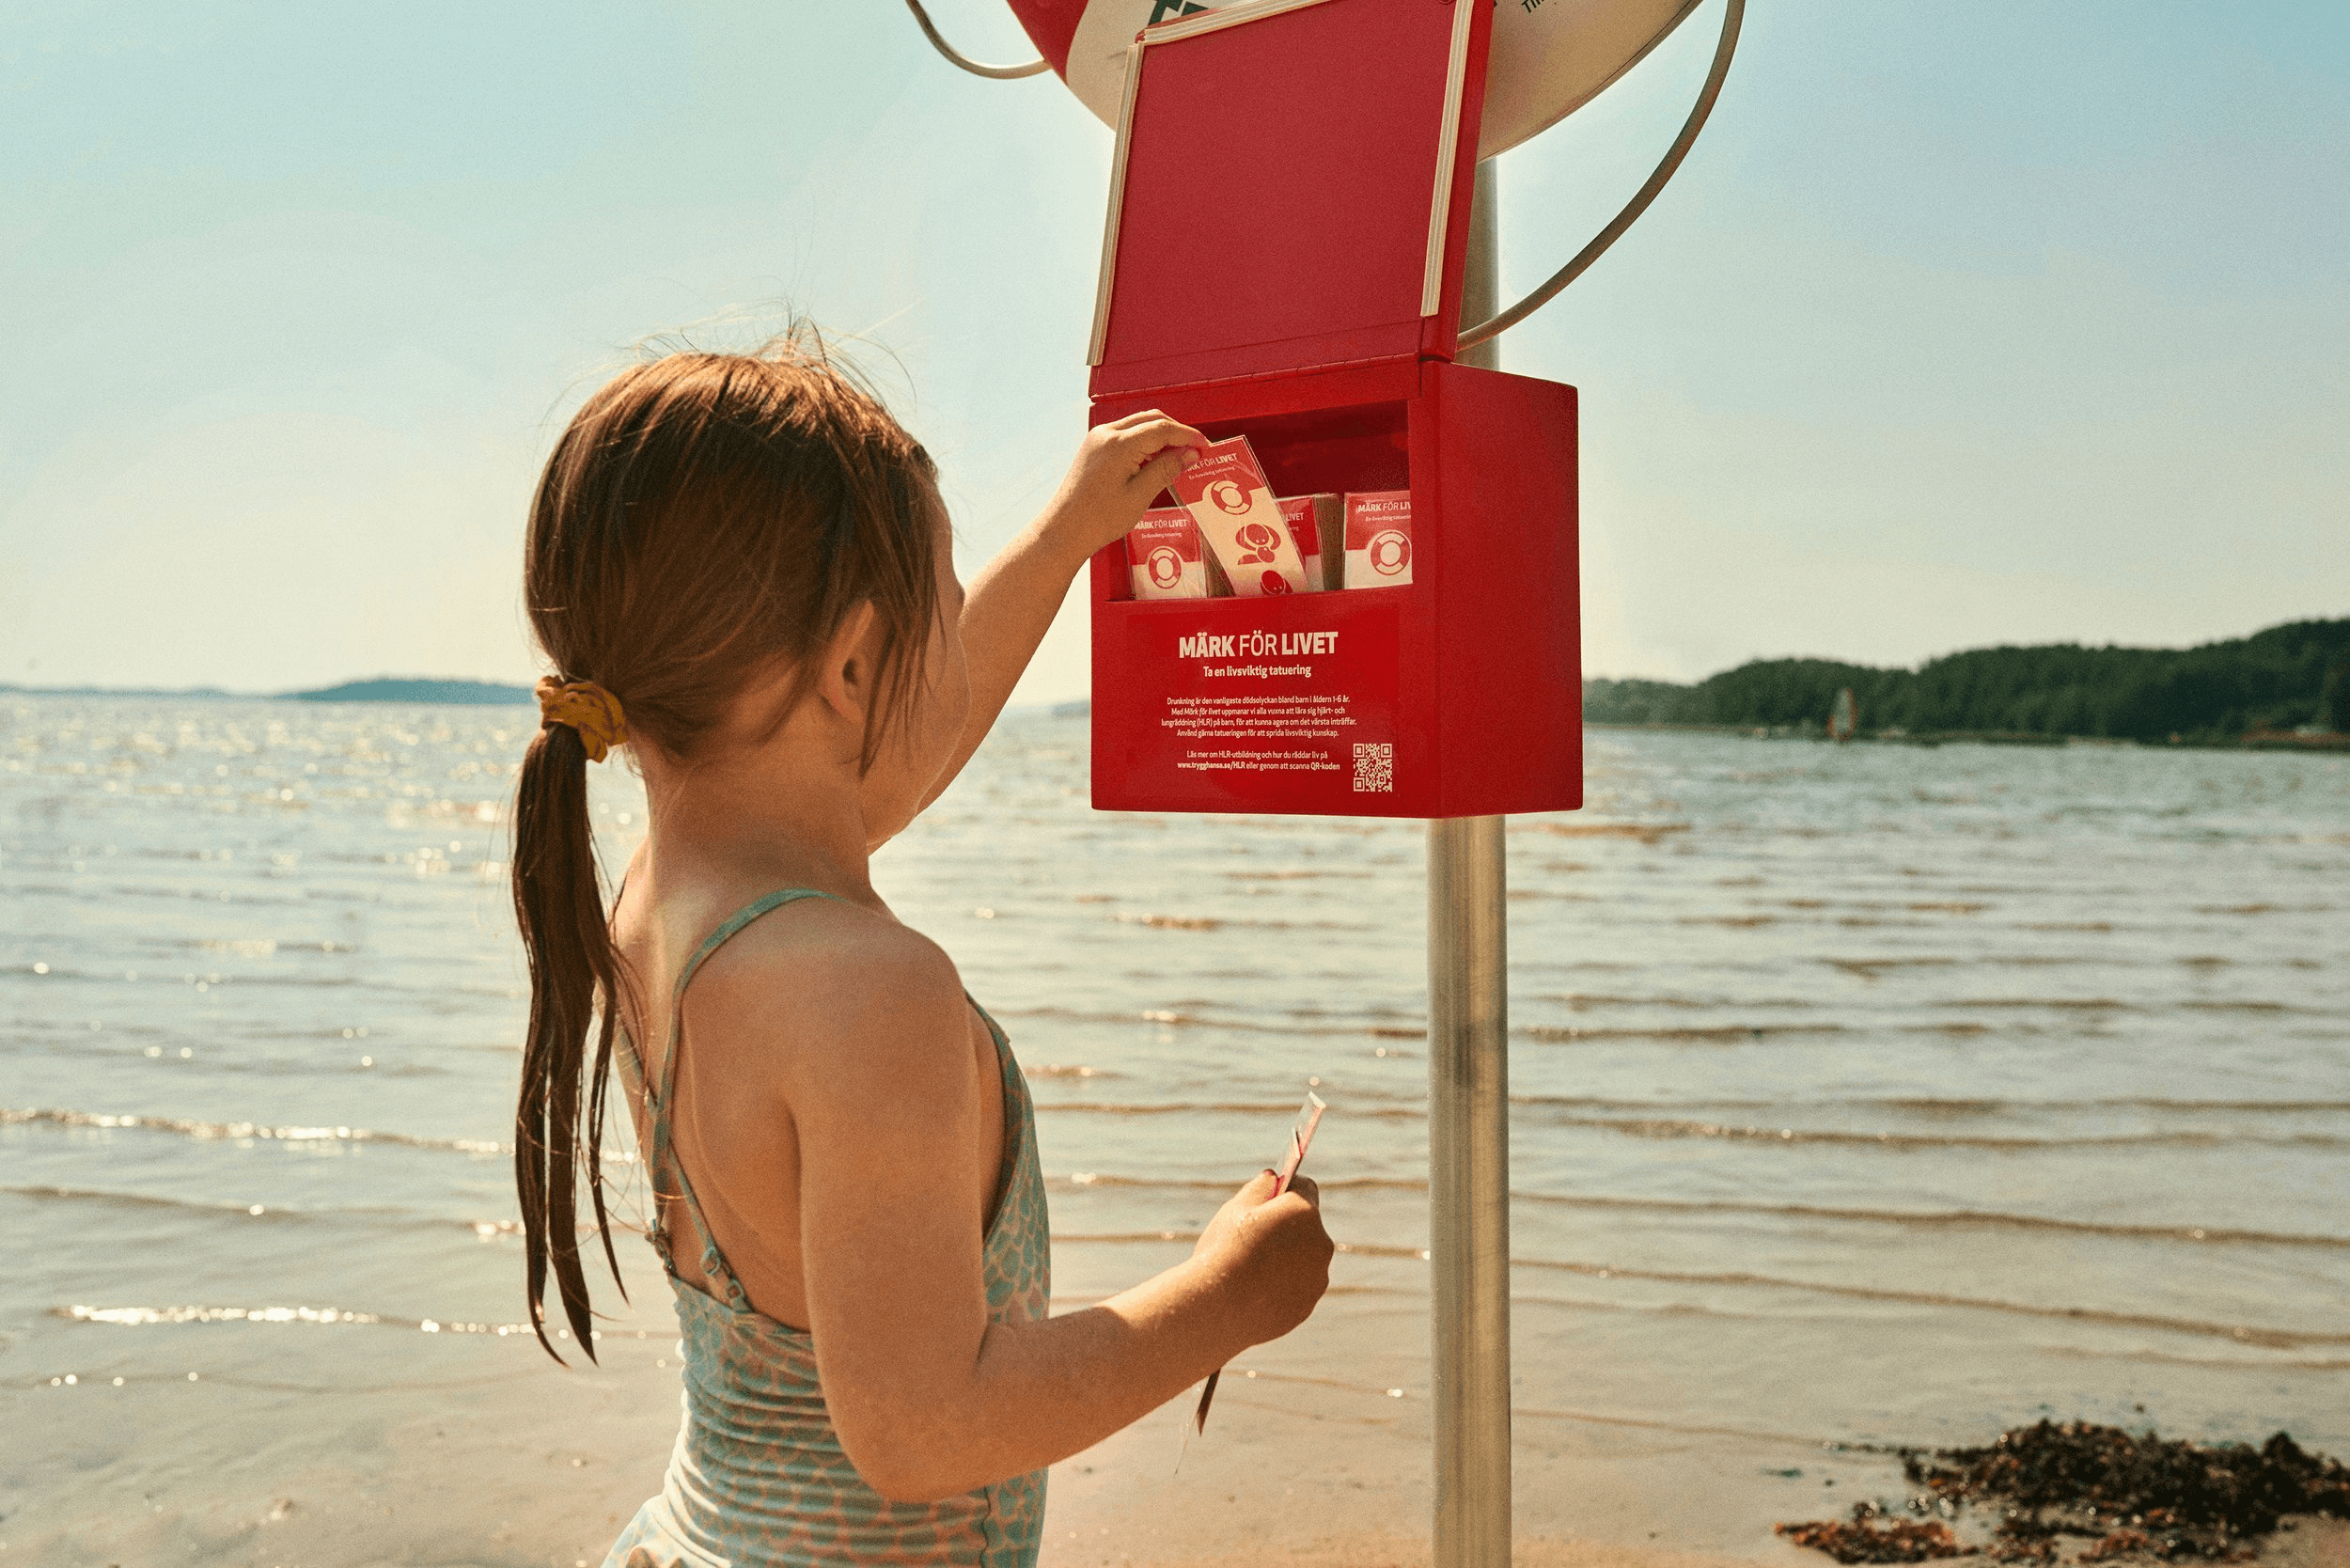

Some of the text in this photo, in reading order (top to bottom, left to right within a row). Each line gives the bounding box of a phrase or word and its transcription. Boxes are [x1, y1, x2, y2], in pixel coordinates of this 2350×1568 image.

[1199, 458, 1216, 468] FÖR
[1215, 452, 1238, 464] LIVET
[1357, 502, 1382, 512] MÄRK
[1383, 500, 1400, 511] FÖR
[1154, 519, 1168, 528] FÖR
[1168, 519, 1187, 527] LIVET
[1179, 629, 1339, 658] MÄRK FÖR LIVET
[1203, 664, 1311, 679] Ta en livsviktig tatuering
[1167, 698, 1195, 707] Drunkning
[1214, 697, 1241, 707] vanligaste
[1242, 696, 1277, 706] dödsolyckan
[1278, 696, 1294, 704] bland
[1295, 696, 1308, 704] barn
[1309, 696, 1312, 704] i
[1313, 695, 1331, 704] åldern
[1342, 695, 1351, 703] år.
[1198, 707, 1208, 717] för
[1208, 707, 1221, 715] livet
[1221, 708, 1249, 717] uppmanar
[1250, 707, 1256, 715] vi
[1256, 707, 1267, 715] alla
[1294, 706, 1307, 714] lära
[1307, 706, 1317, 716] sig
[1334, 706, 1345, 714] och
[1161, 718, 1197, 728] lungräddning
[1197, 717, 1213, 727] (HLR)
[1213, 717, 1220, 728] på
[1220, 718, 1235, 727] barn,
[1272, 719, 1289, 728] agera
[1310, 717, 1330, 726] värsta
[1330, 717, 1356, 726] inträffar.
[1198, 729, 1214, 739] gärna
[1214, 729, 1246, 739] tatueringen
[1247, 729, 1257, 737] för
[1265, 729, 1285, 738] sprida
[1285, 729, 1312, 738] livsviktig
[1312, 729, 1340, 738] kunskap.
[1218, 750, 1261, 760] HLR-utbildning
[1261, 750, 1273, 759] och
[1292, 750, 1311, 759] räddar
[1311, 750, 1320, 759] liv
[1320, 750, 1328, 760] på
[1177, 760, 1246, 771] www.trygghansa.se/HLR
[1246, 761, 1260, 770] eller
[1260, 762, 1279, 771] genom
[1310, 761, 1340, 771] QR-koden
